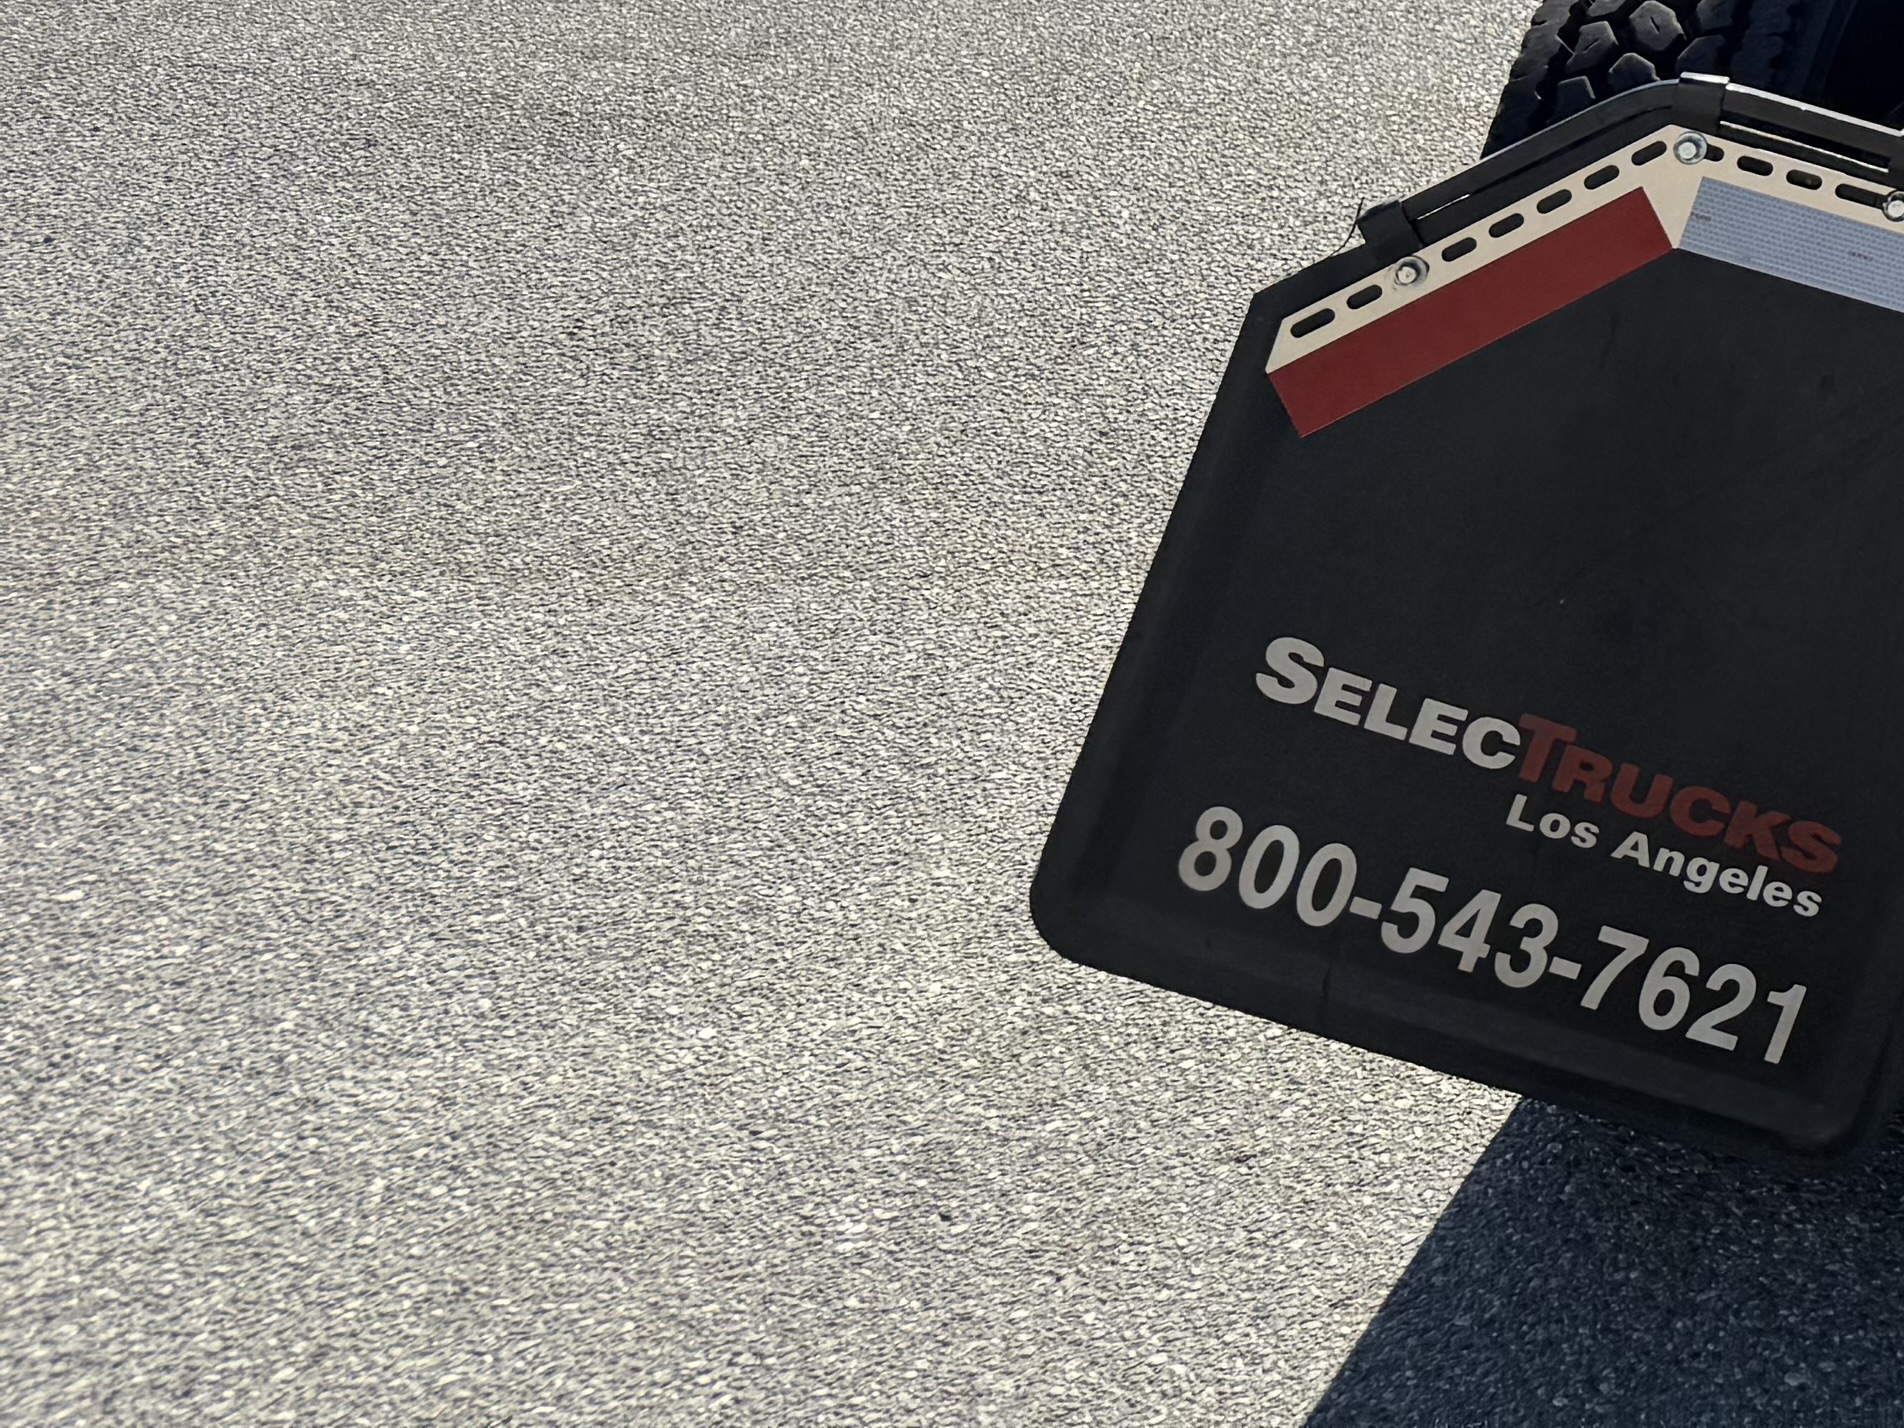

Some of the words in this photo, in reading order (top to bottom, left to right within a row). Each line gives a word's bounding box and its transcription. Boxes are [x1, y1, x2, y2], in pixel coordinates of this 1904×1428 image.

[1178, 806, 1807, 1065] 800-543-7621
[1505, 793, 1600, 849] Los
[1610, 831, 1822, 917] Angeles
